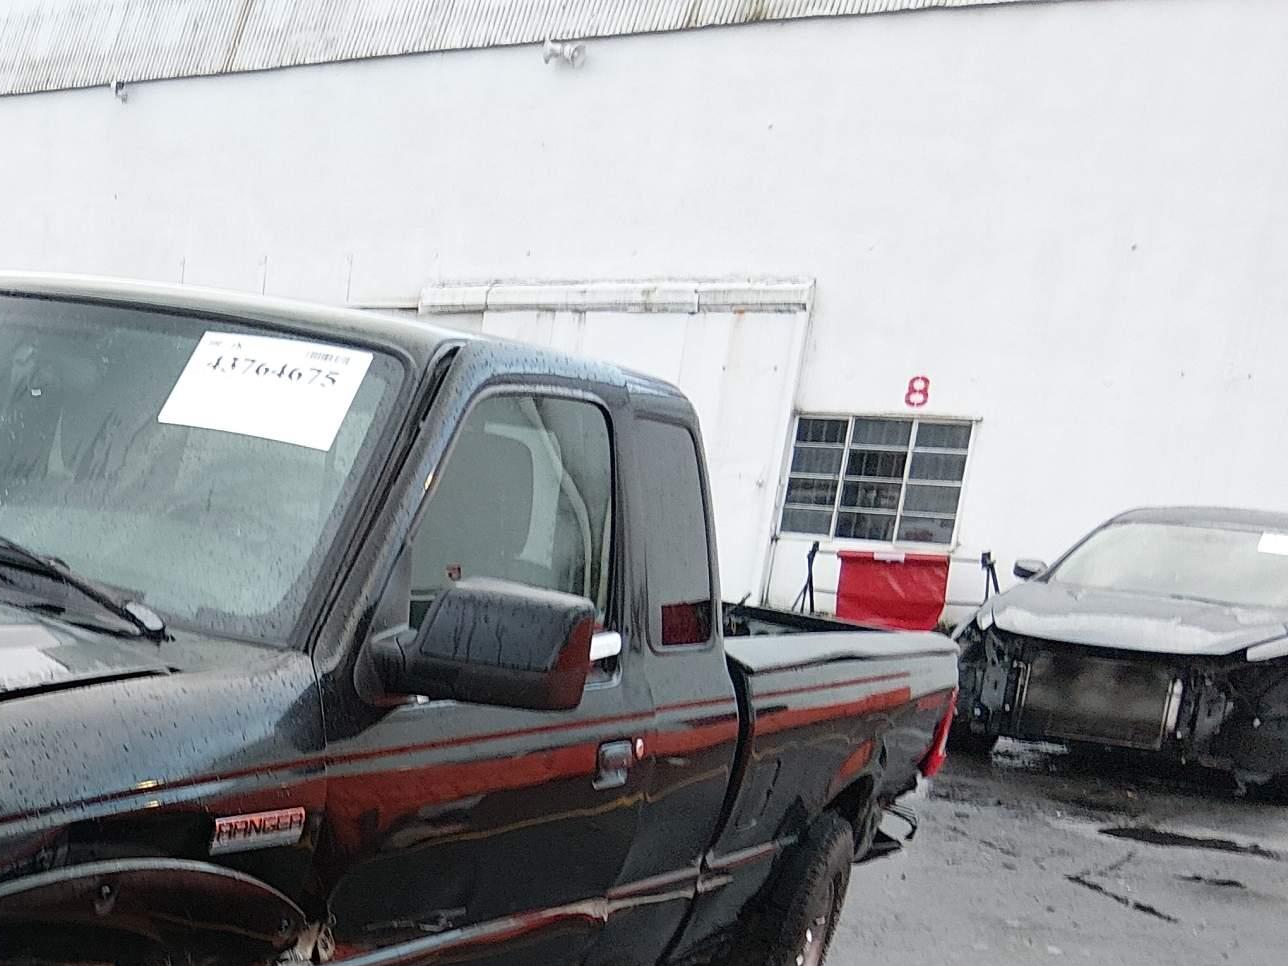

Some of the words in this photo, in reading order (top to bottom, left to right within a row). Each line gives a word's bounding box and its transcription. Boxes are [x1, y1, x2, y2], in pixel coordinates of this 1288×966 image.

[207, 354, 341, 388] 43764675
[905, 376, 930, 407] 8
[216, 811, 304, 843] RANGER
